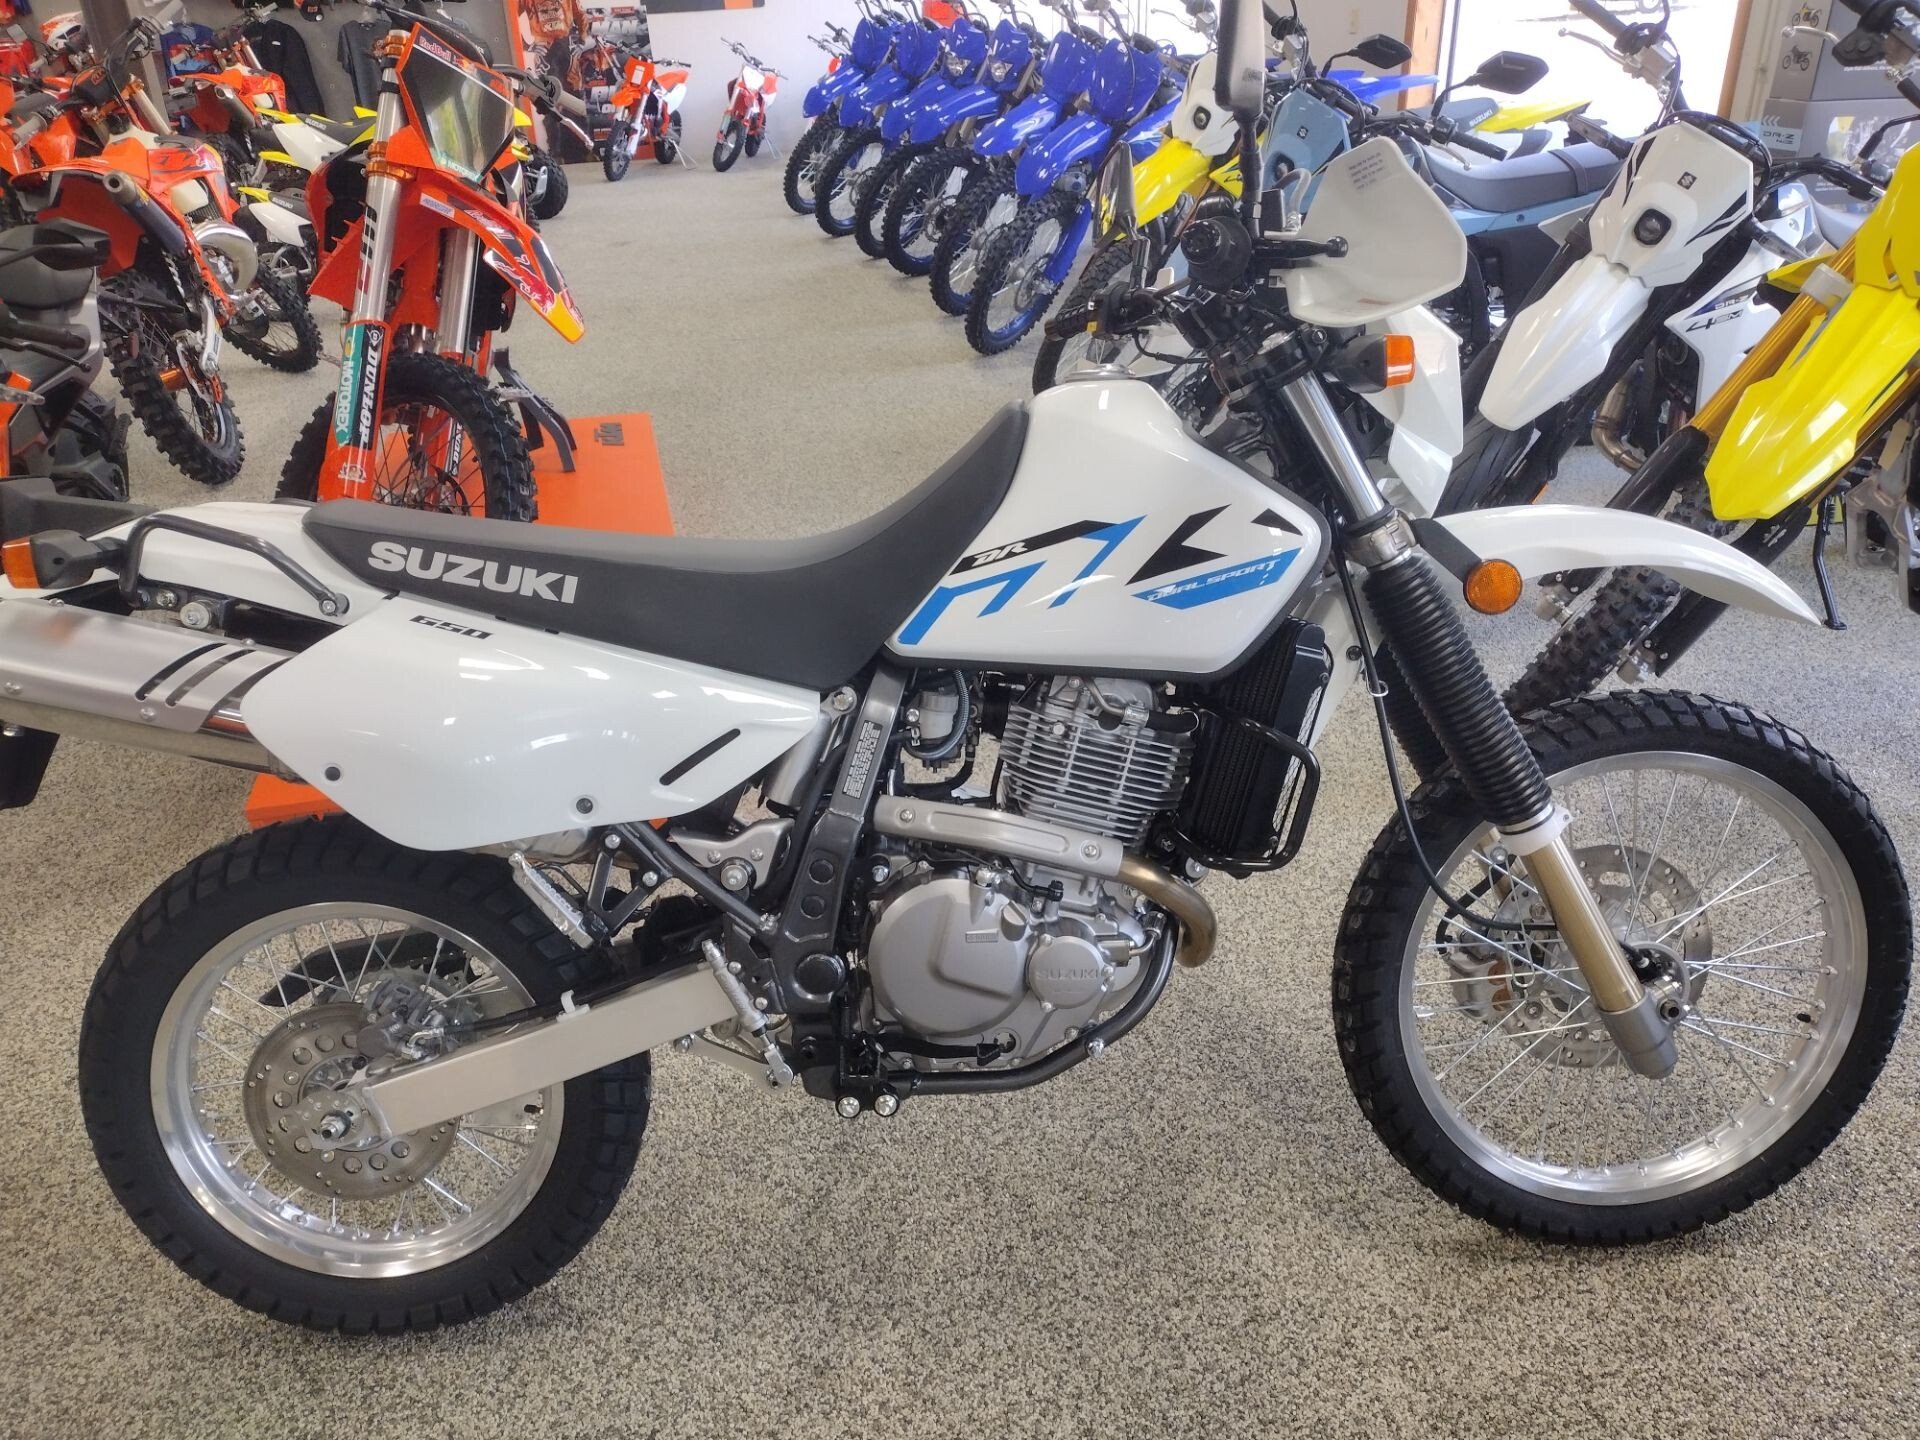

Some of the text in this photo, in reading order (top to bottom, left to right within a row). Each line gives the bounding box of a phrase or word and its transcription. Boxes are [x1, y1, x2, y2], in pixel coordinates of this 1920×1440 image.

[1469, 108, 1493, 127] SUZUKI
[336, 360, 354, 435] MOTOREX
[358, 348, 378, 443] DUNLOP
[971, 541, 1028, 567] DR
[368, 541, 579, 604] SUZUKI
[409, 615, 494, 640] 650
[1036, 968, 1100, 980] SUZUKI
